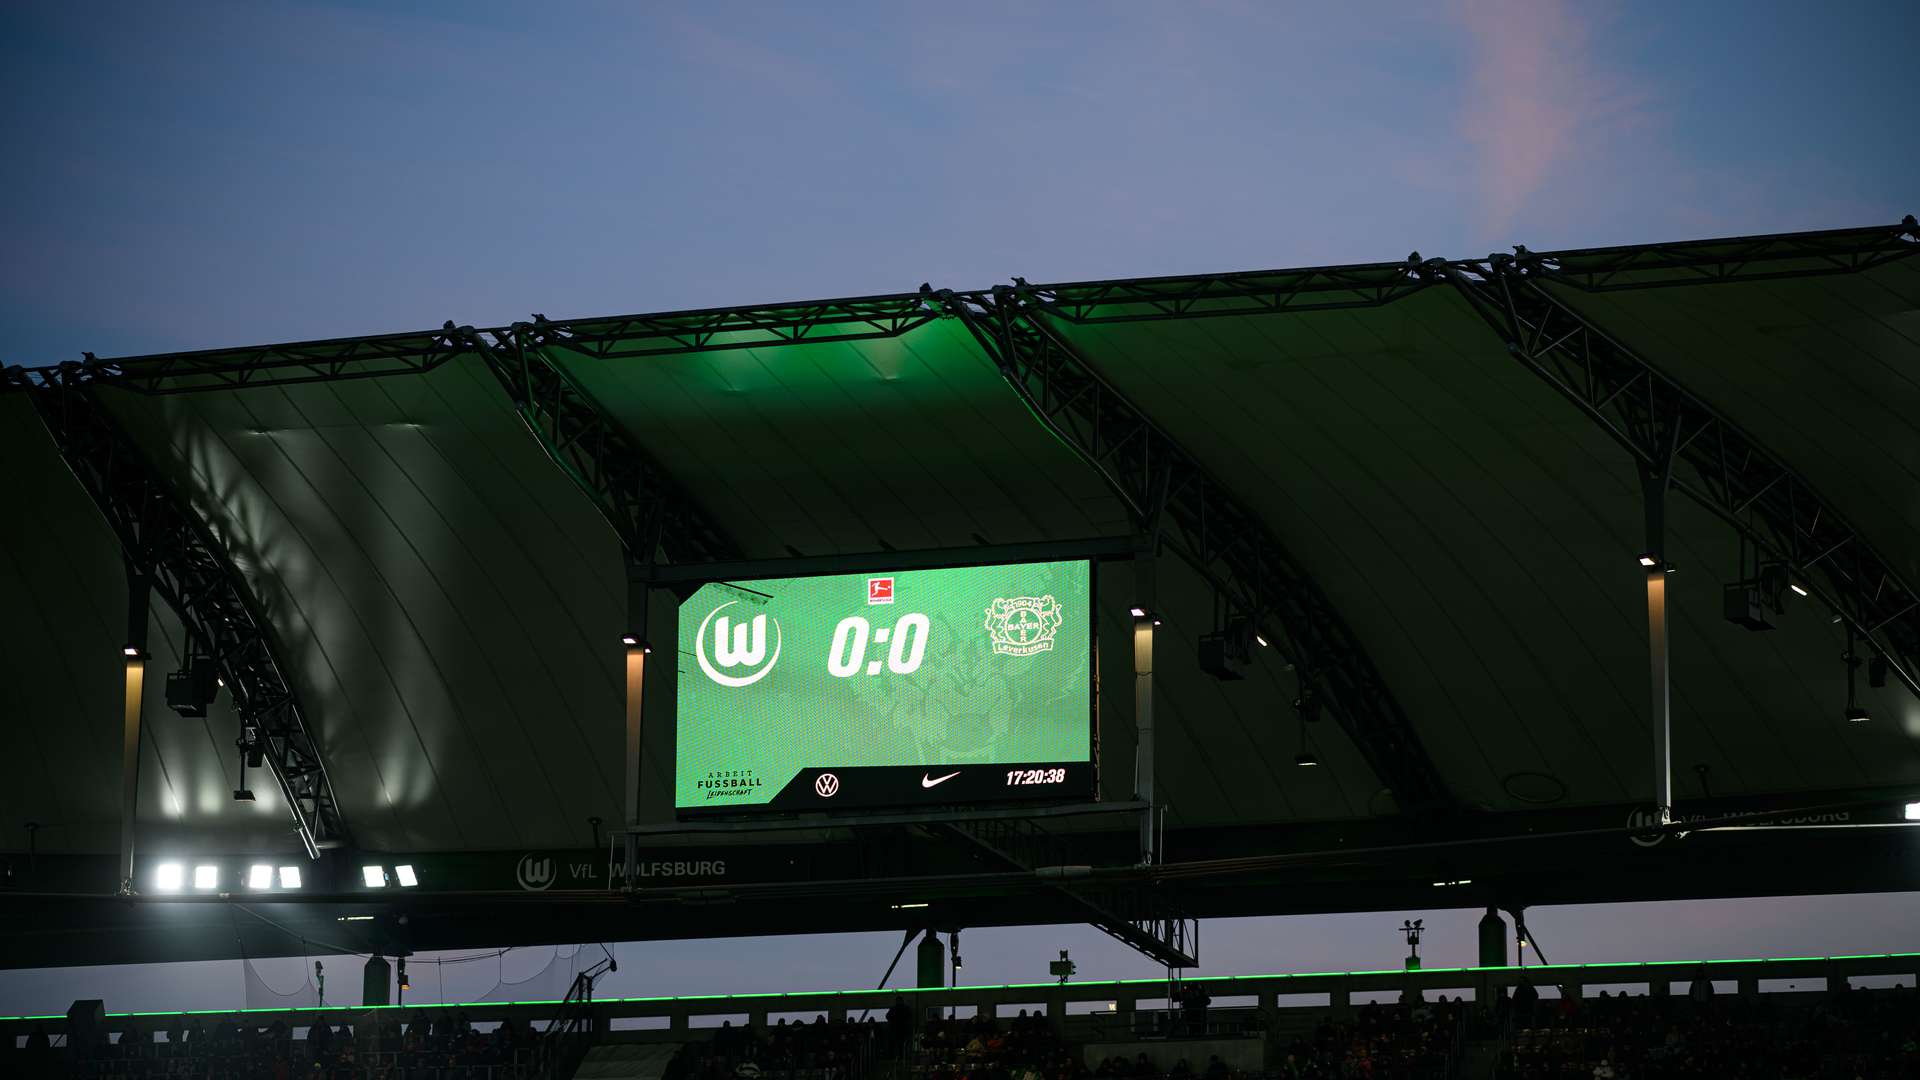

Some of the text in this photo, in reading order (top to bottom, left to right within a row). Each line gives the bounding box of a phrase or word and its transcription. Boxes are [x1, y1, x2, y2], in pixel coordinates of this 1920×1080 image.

[1007, 623, 1039, 631] BAYER
[715, 614, 767, 667] W
[828, 613, 930, 678] 0:0
[998, 642, 1049, 653] Leverkusen
[708, 770, 752, 778] ARBEIT
[1007, 768, 1065, 785] 17:20:38
[697, 778, 763, 789] FUSSBALL
[569, 860, 726, 879] VfL WLFSBURG
